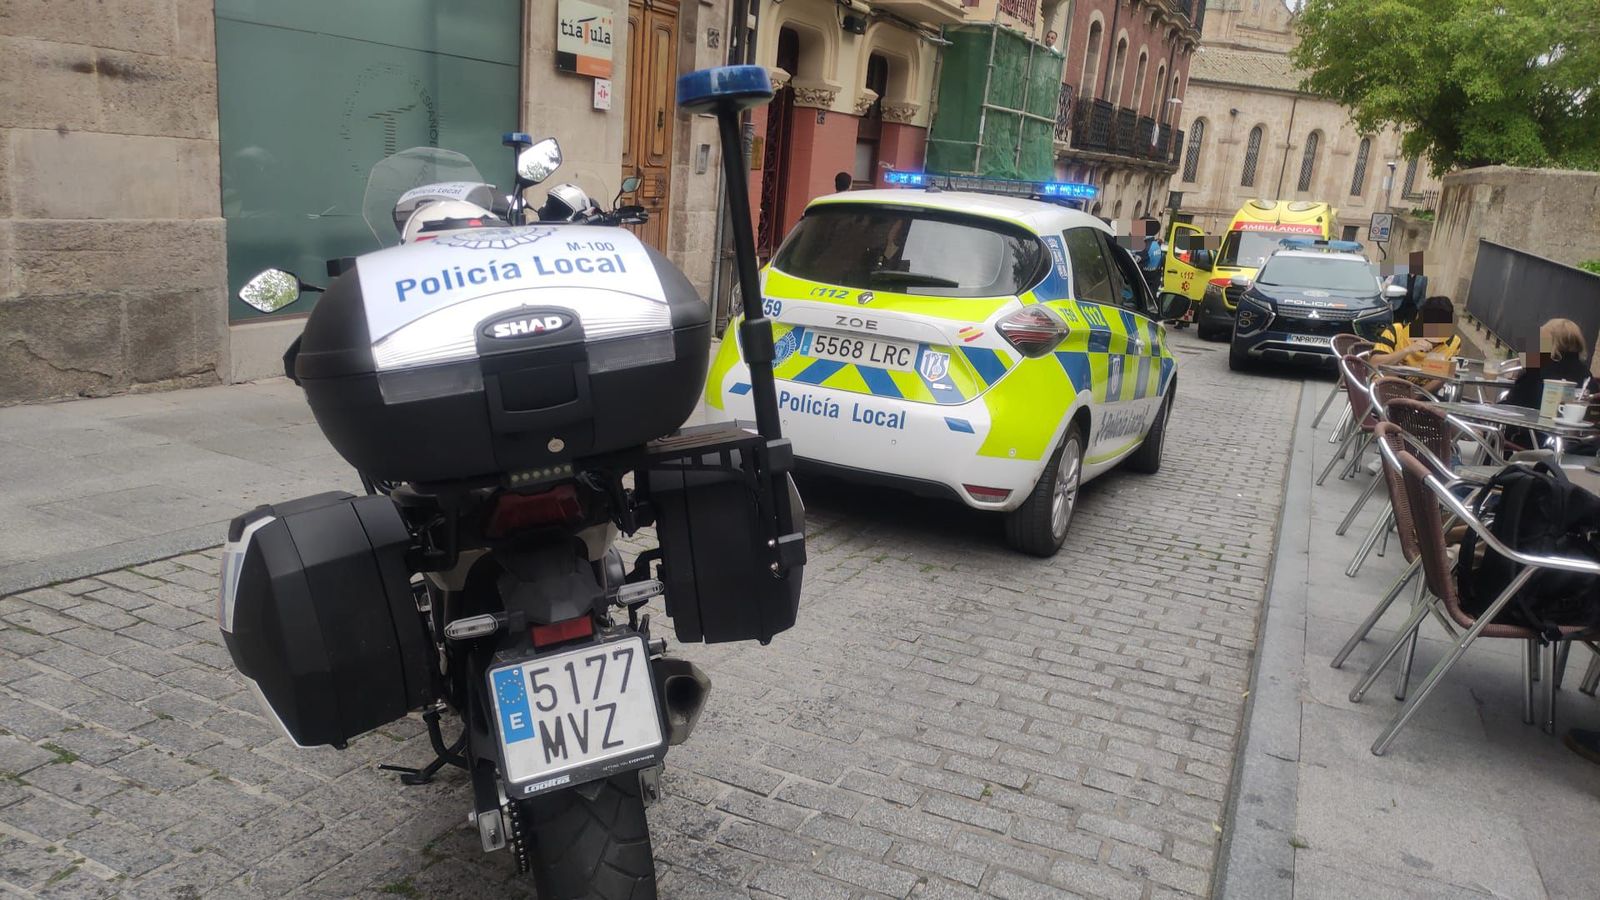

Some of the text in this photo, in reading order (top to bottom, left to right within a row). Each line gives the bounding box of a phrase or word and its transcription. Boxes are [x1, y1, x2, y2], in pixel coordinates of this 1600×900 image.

[1240, 223, 1315, 234] AMBULANCIA
[566, 241, 615, 252] M-100
[395, 254, 627, 302] Policía Local
[816, 287, 850, 299] 112
[494, 316, 563, 338] SHAD
[835, 315, 879, 331] ZOE
[814, 334, 864, 359] 5568
[869, 342, 911, 367] LRC
[779, 390, 907, 430] Policía Local
[529, 647, 634, 712] 5177
[509, 711, 525, 730] E
[538, 702, 624, 765] MVZ
